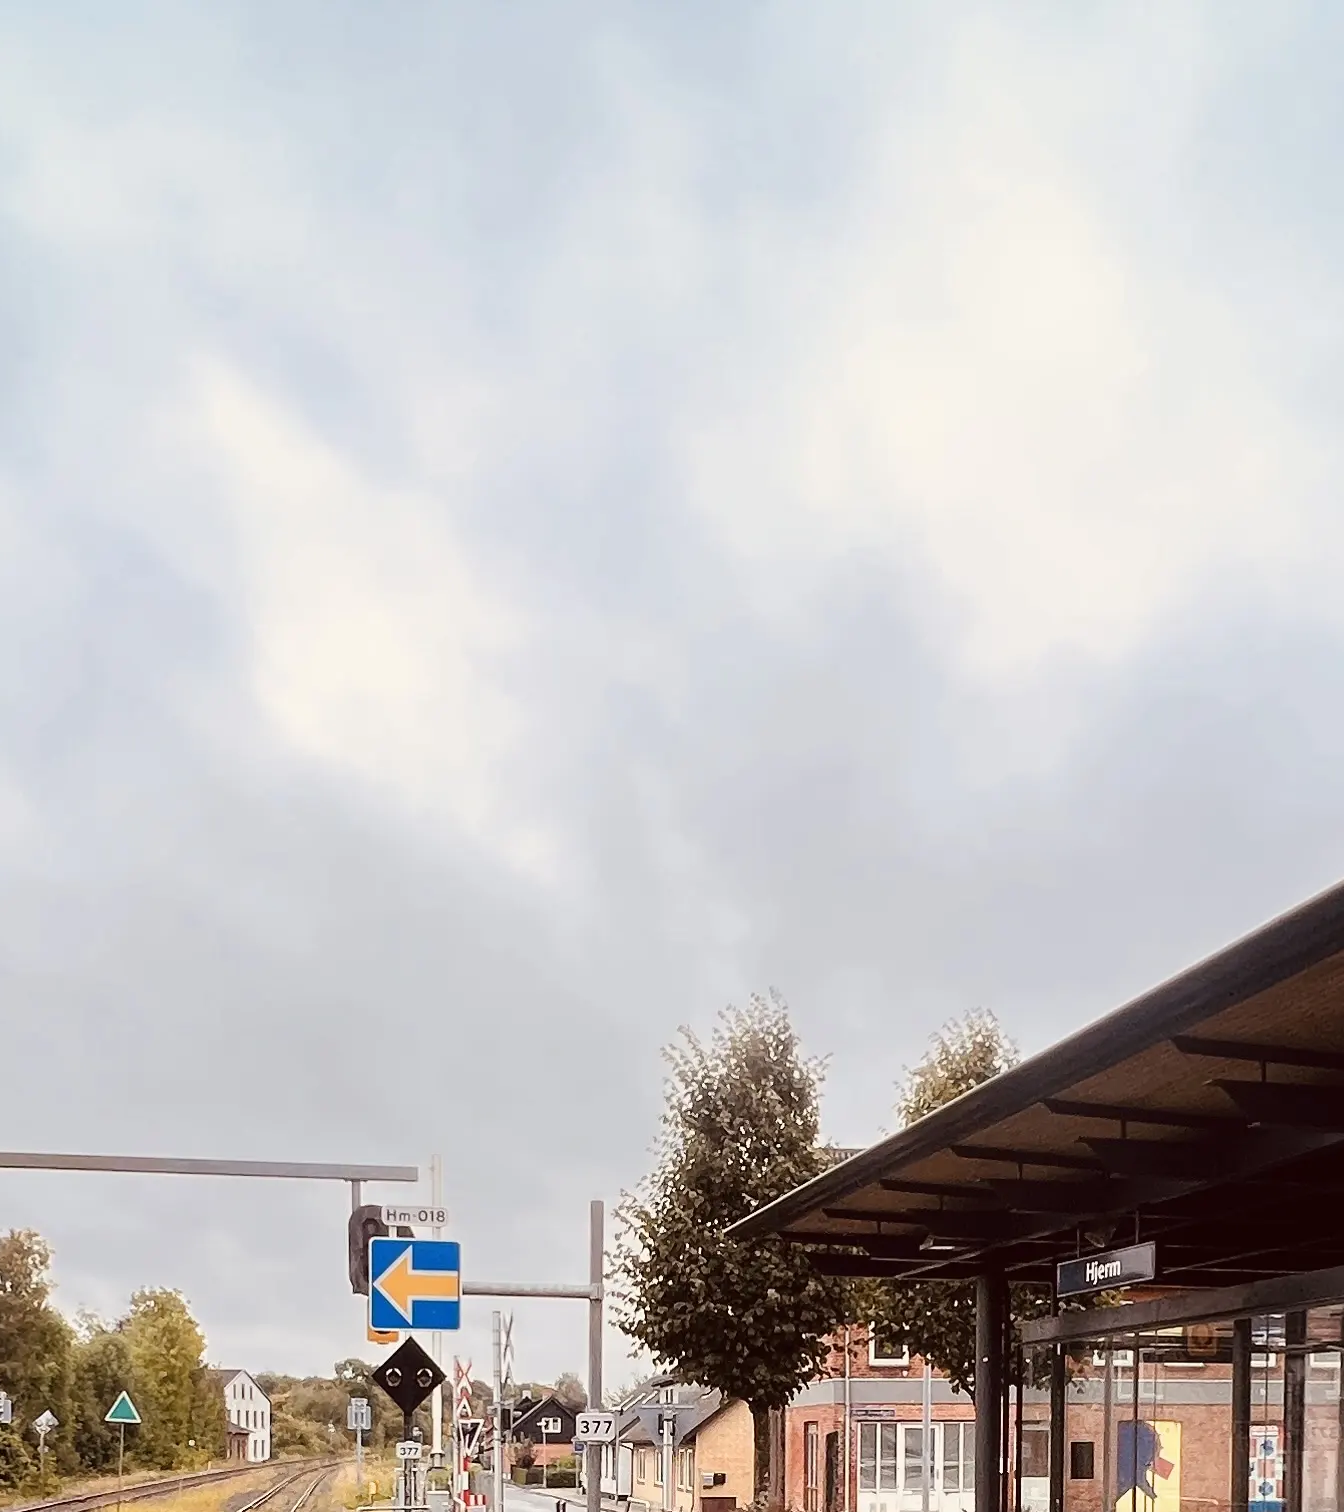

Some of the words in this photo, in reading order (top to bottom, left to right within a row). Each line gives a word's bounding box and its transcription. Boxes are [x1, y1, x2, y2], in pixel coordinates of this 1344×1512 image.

[386, 1209, 445, 1222] Hm-018
[1085, 1260, 1121, 1285] Hjerm
[580, 1420, 613, 1434] 377
[399, 1447, 419, 1456] 377
